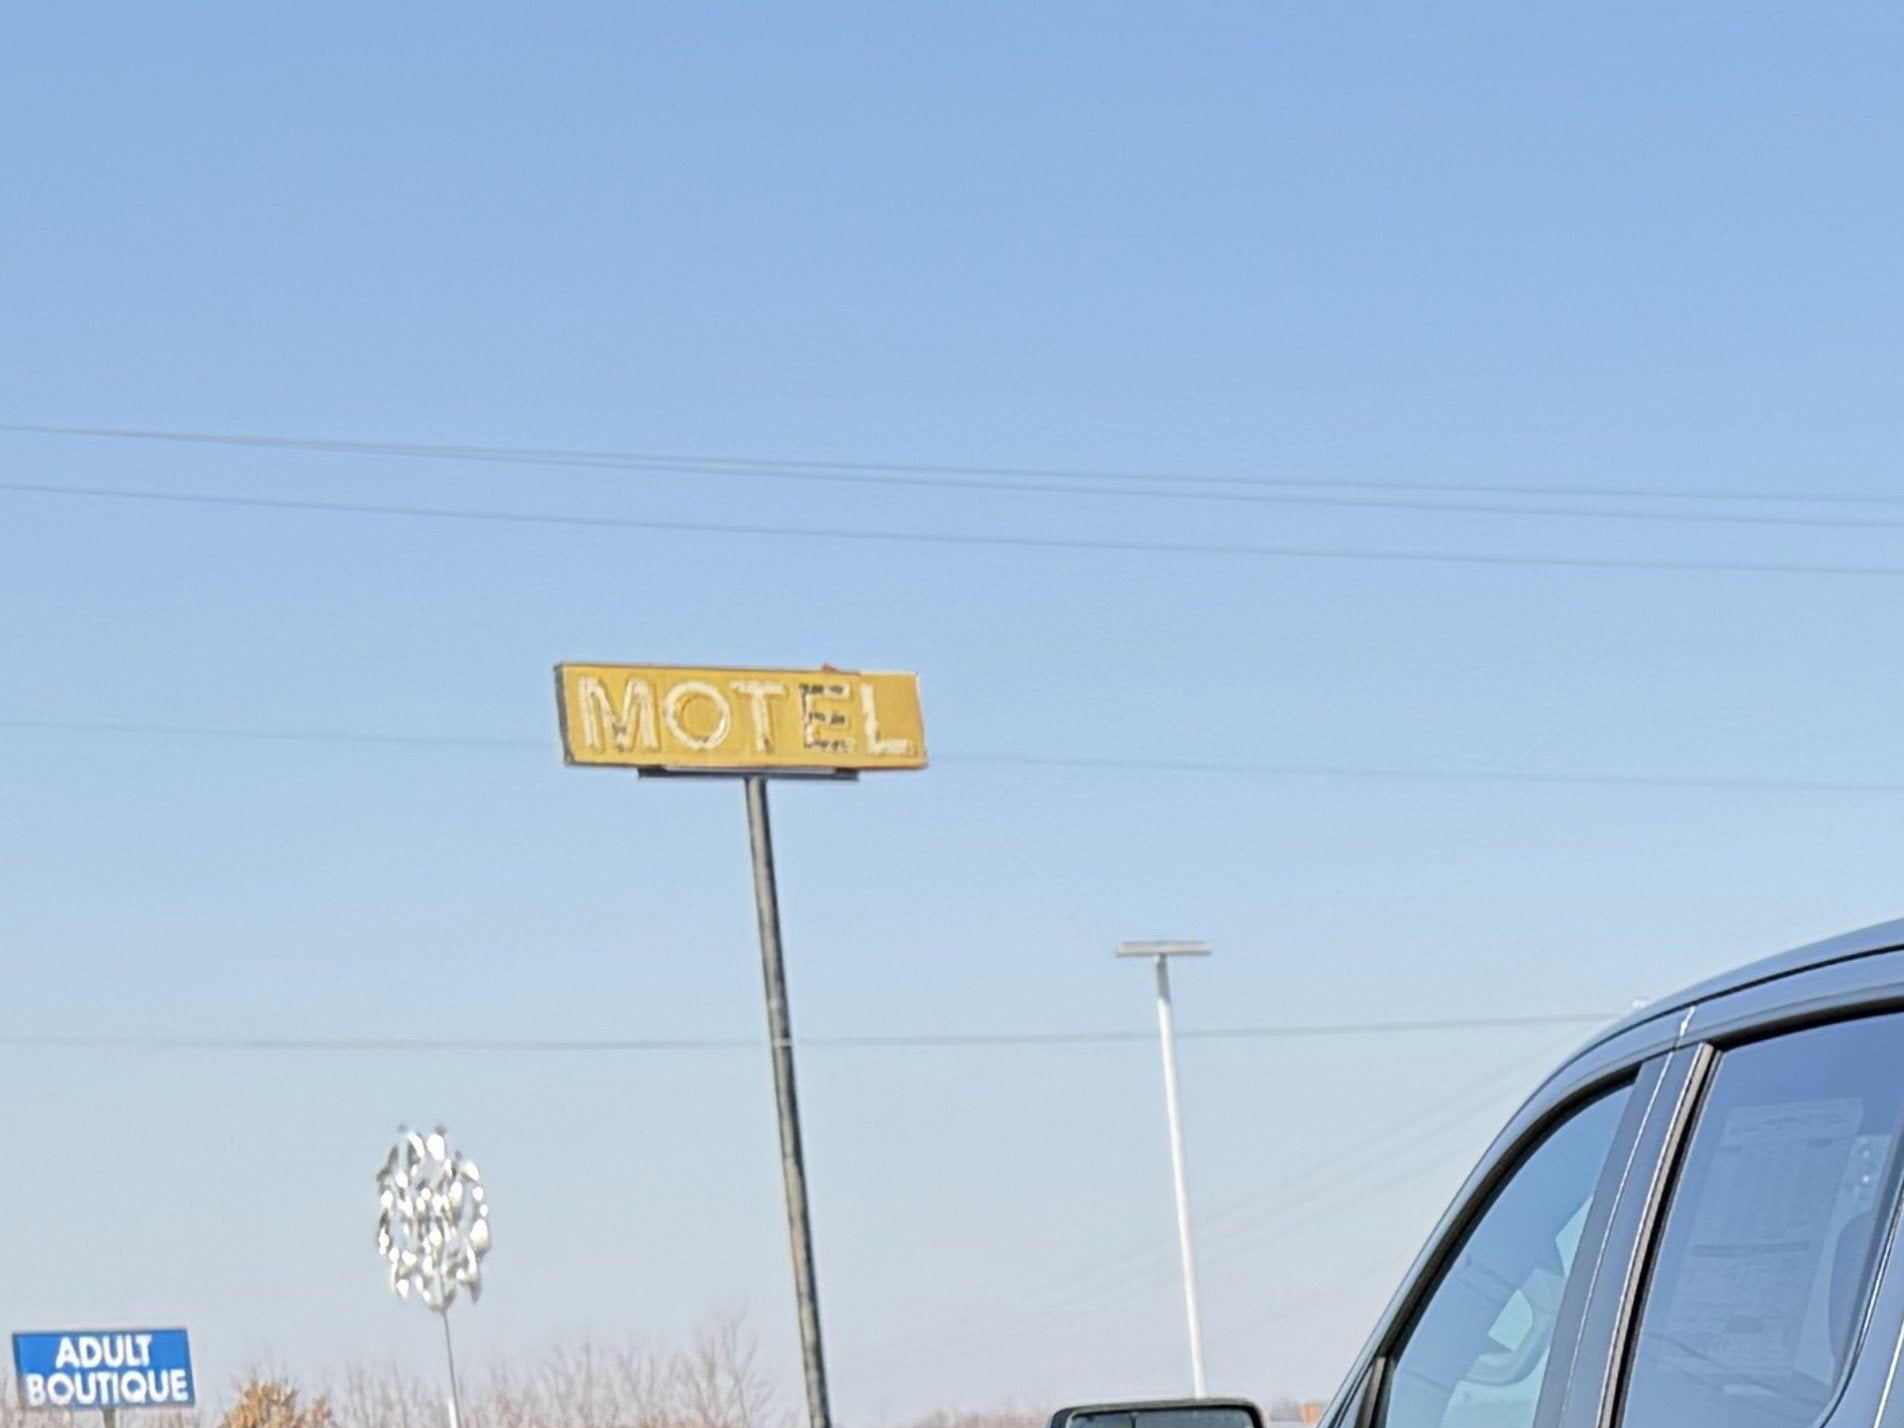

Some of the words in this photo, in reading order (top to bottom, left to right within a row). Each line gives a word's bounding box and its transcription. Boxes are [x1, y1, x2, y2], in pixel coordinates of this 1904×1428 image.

[578, 675, 913, 754] MOTEL
[55, 1334, 153, 1369] ADULT
[26, 1368, 190, 1407] BOUTIQUE
